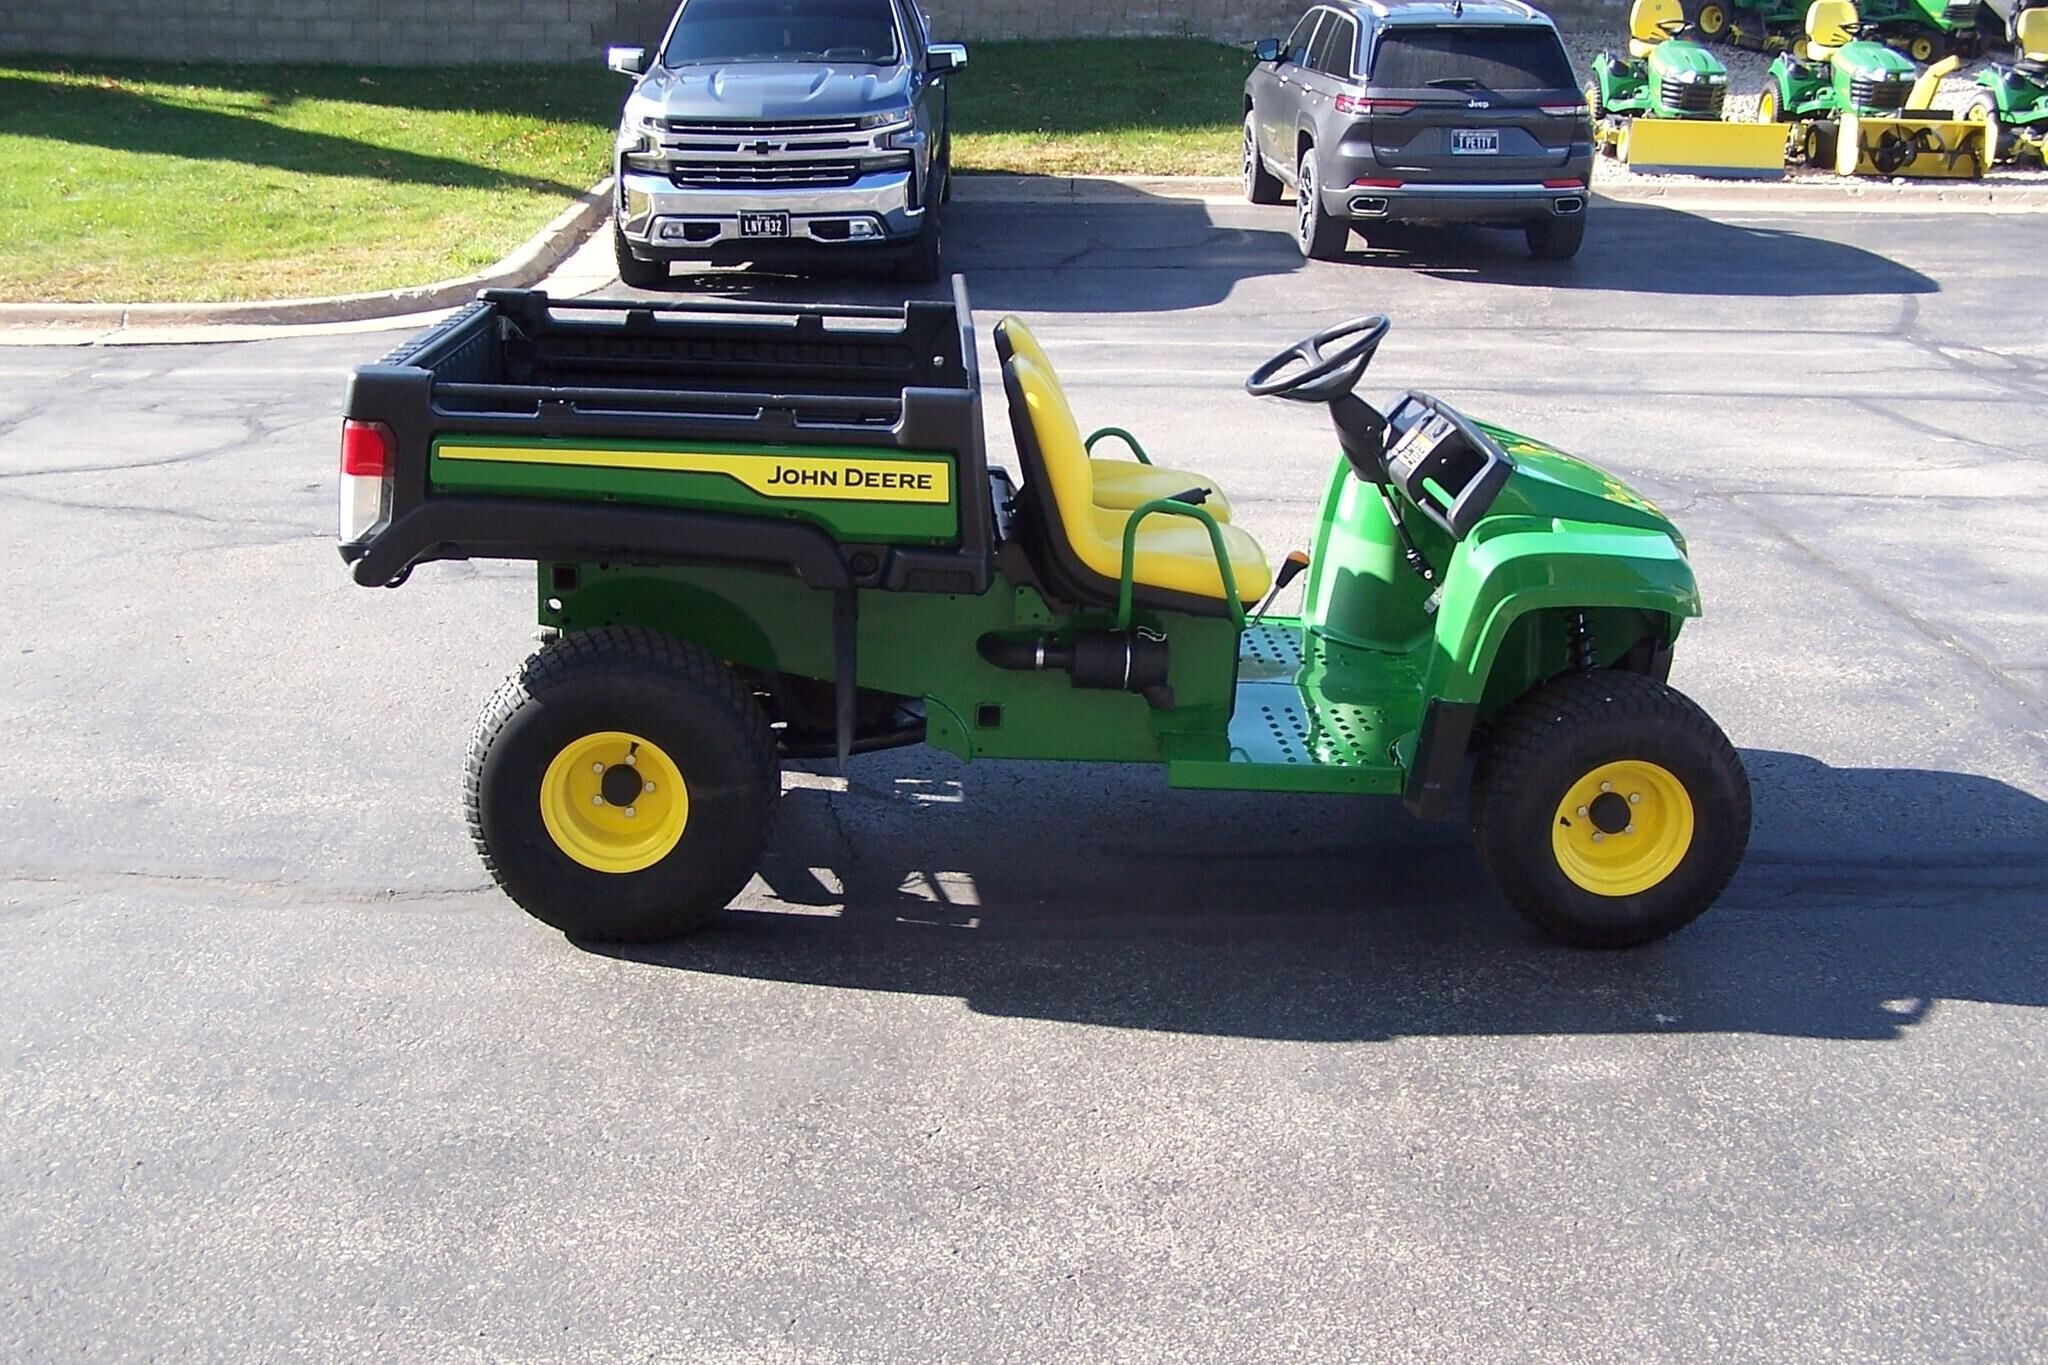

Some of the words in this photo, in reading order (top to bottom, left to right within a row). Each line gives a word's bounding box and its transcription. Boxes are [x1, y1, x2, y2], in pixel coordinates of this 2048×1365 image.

[1467, 99, 1489, 109] Jeep
[1466, 137, 1491, 148] PETTY
[745, 220, 761, 232] LNY
[765, 220, 781, 232] 932
[767, 465, 838, 486] JOHN
[845, 468, 932, 489] DEERE
